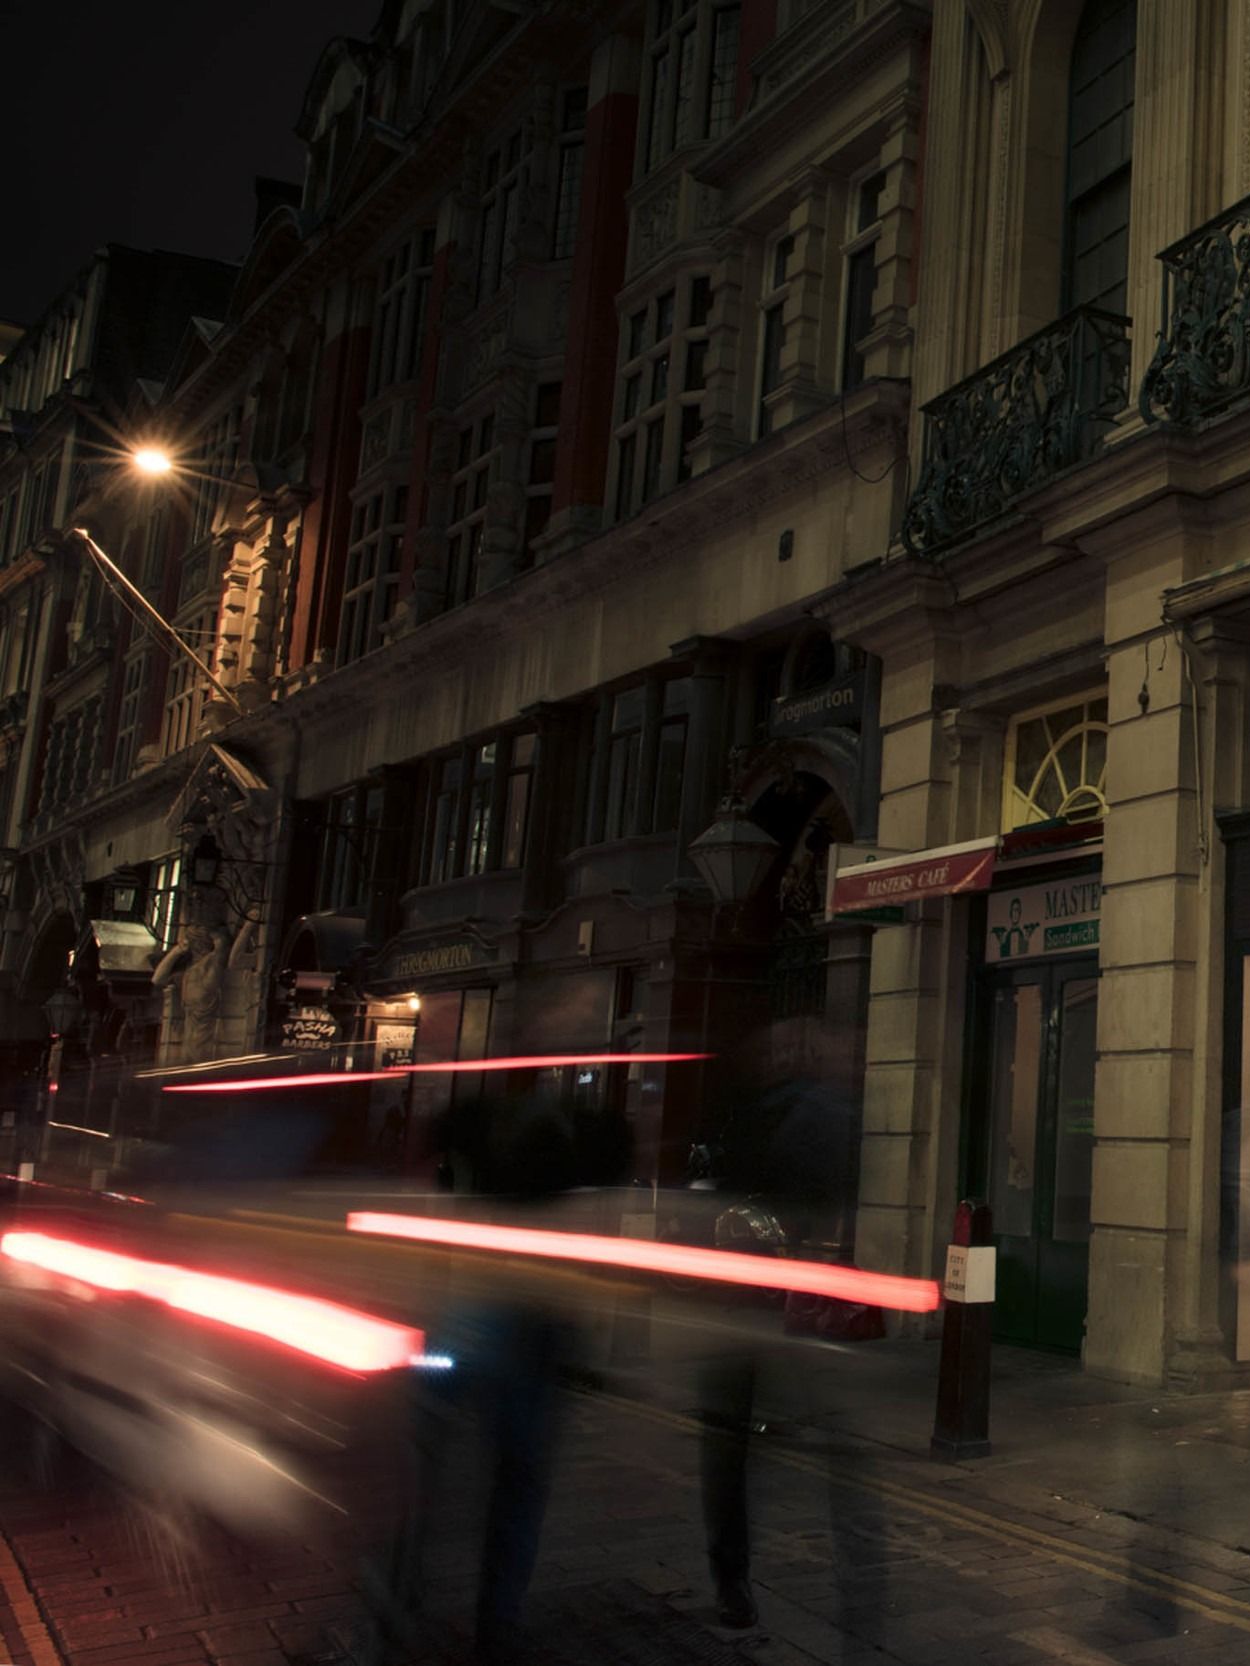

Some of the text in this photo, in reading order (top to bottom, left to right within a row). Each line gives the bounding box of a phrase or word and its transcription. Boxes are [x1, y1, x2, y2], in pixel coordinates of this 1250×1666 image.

[866, 862, 949, 897] MASTERS CAFÉ
[1046, 927, 1095, 948] Sandwich
[282, 1021, 336, 1037] PASHA
